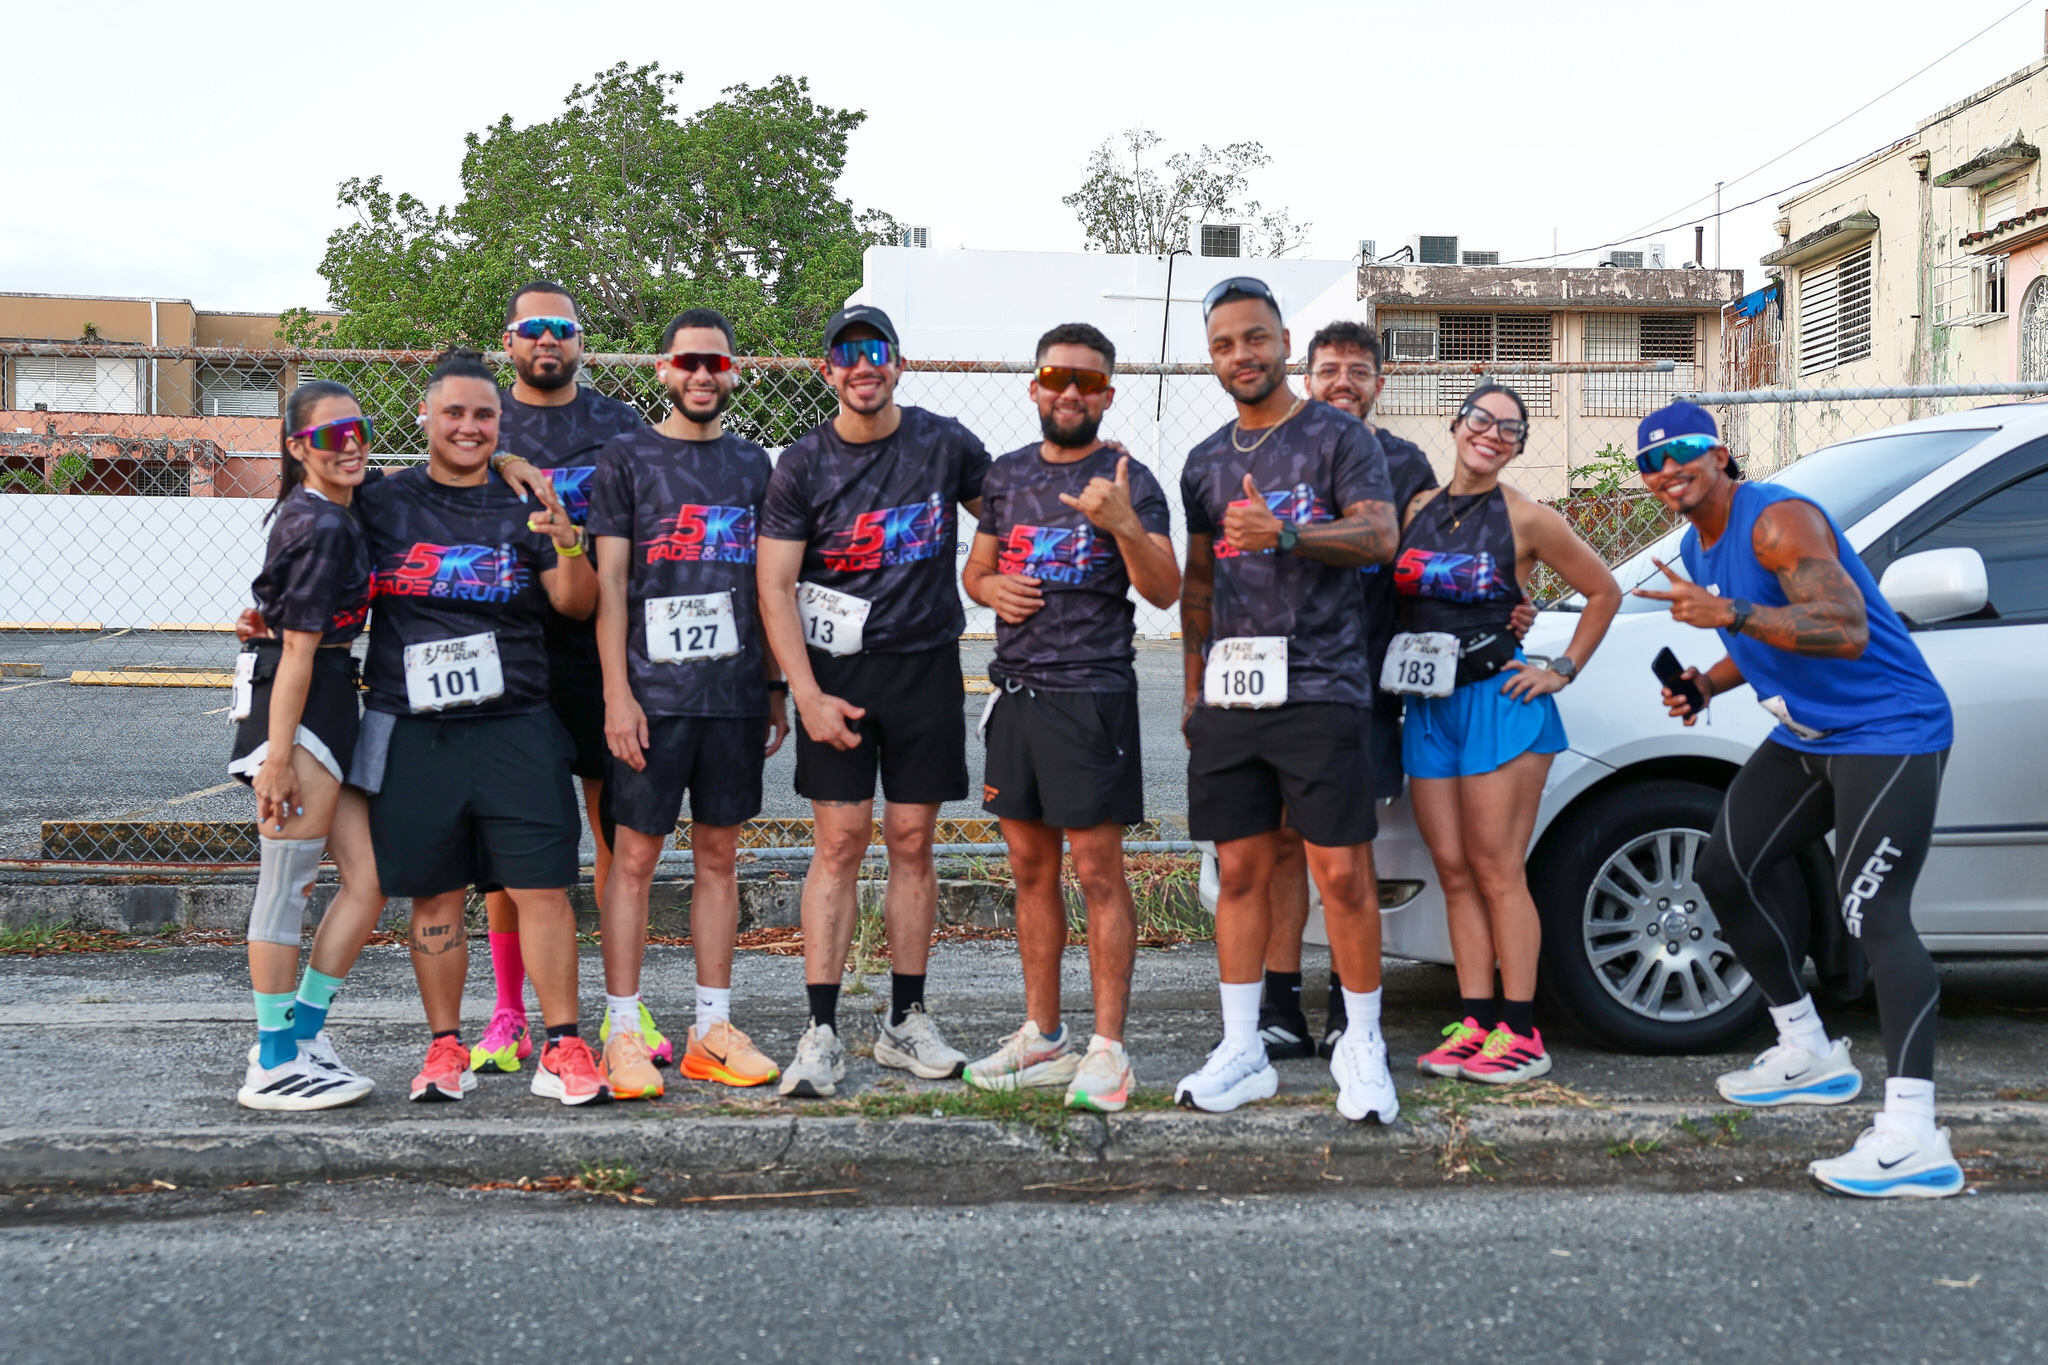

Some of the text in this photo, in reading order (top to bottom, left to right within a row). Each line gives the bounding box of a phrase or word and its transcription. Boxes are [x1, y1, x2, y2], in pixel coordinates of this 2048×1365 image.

[540, 466, 597, 506] K
[669, 504, 746, 545] 5K
[845, 502, 927, 555] 5K
[647, 544, 702, 565] FADE
[898, 541, 941, 564] RUN
[1002, 524, 1073, 562] 5K
[394, 542, 495, 581] 5K
[1034, 564, 1084, 585] RUN
[1393, 547, 1475, 585] 5K
[376, 579, 433, 596] FADE
[451, 582, 511, 603] RUN
[669, 624, 718, 652] 127
[810, 615, 834, 645] 13
[454, 650, 479, 661] RUN
[428, 667, 479, 698] 101
[1222, 670, 1264, 695] 180
[1398, 660, 1435, 686] 183
[1842, 836, 1902, 938] SPORT
